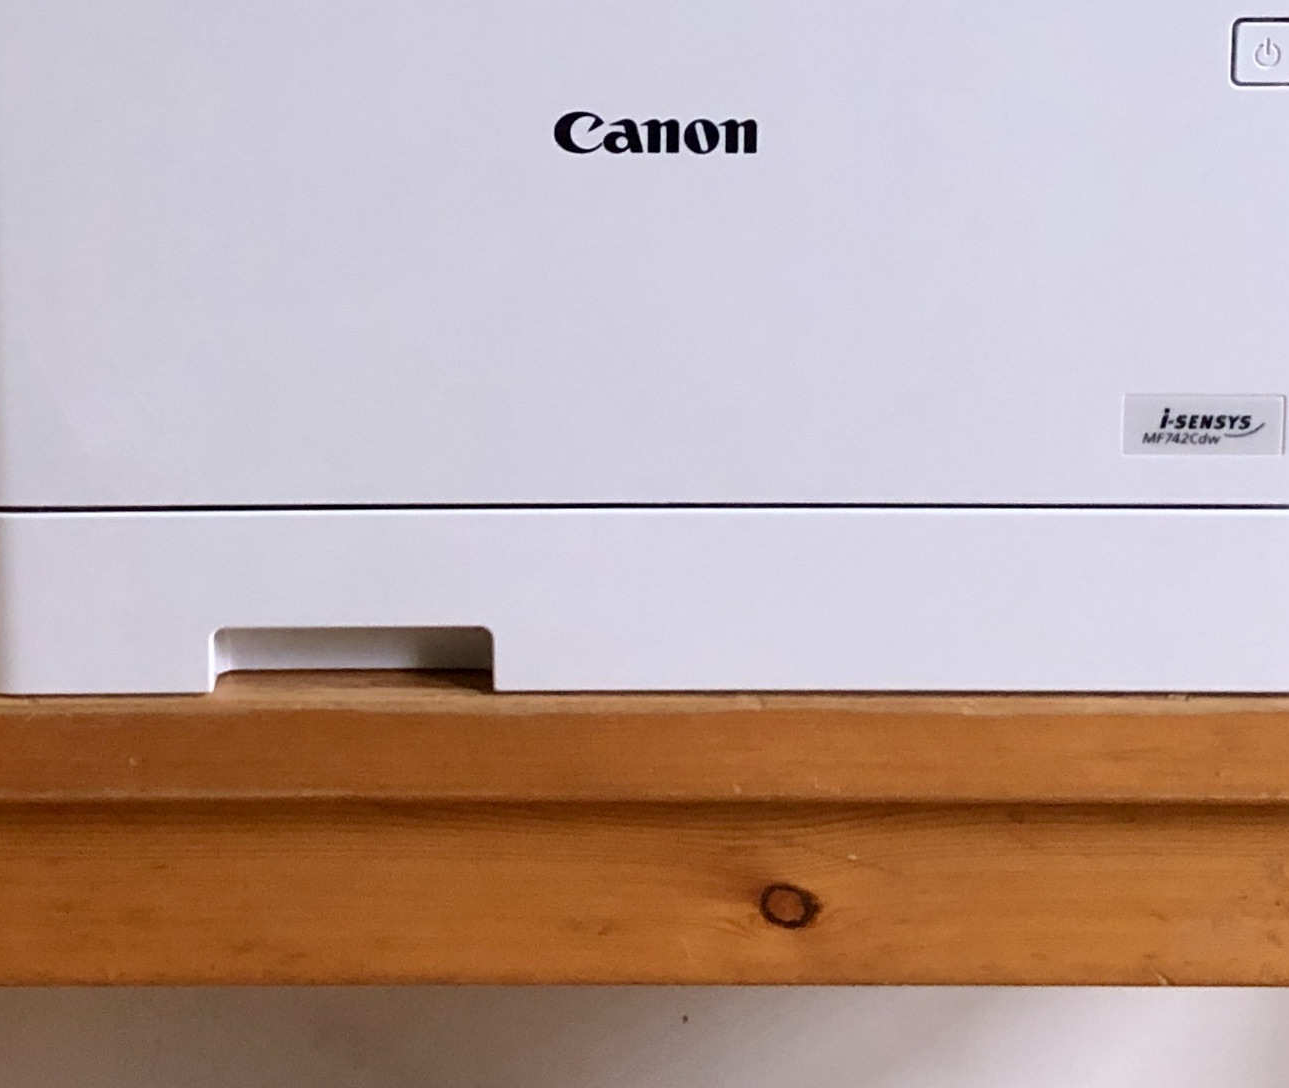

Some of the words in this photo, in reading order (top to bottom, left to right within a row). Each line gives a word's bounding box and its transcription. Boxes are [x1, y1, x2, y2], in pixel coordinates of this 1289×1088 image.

[554, 111, 757, 154] Canon
[1160, 408, 1252, 430] i-SENSYS
[1142, 432, 1221, 445] MF742Cdw
